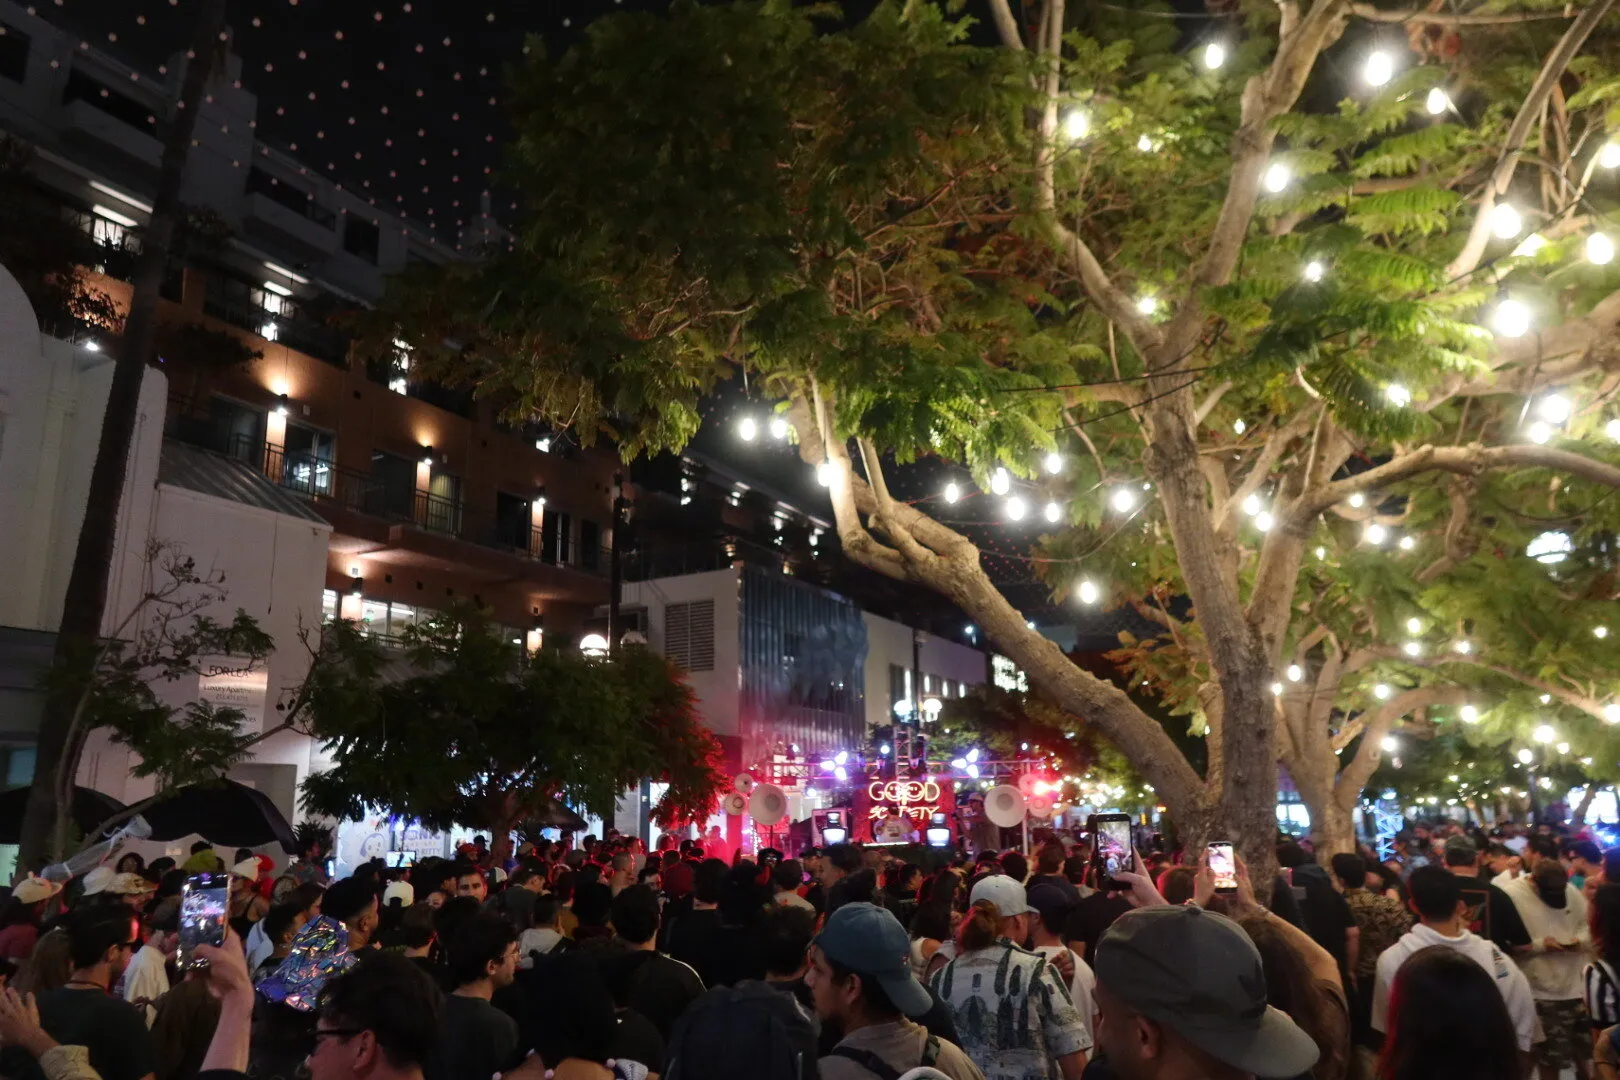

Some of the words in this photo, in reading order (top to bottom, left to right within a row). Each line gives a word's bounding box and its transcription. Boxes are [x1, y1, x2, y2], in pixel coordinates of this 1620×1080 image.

[209, 665, 229, 676] FOR
[868, 781, 941, 802] GOOD
[868, 805, 940, 820] SOIETY
